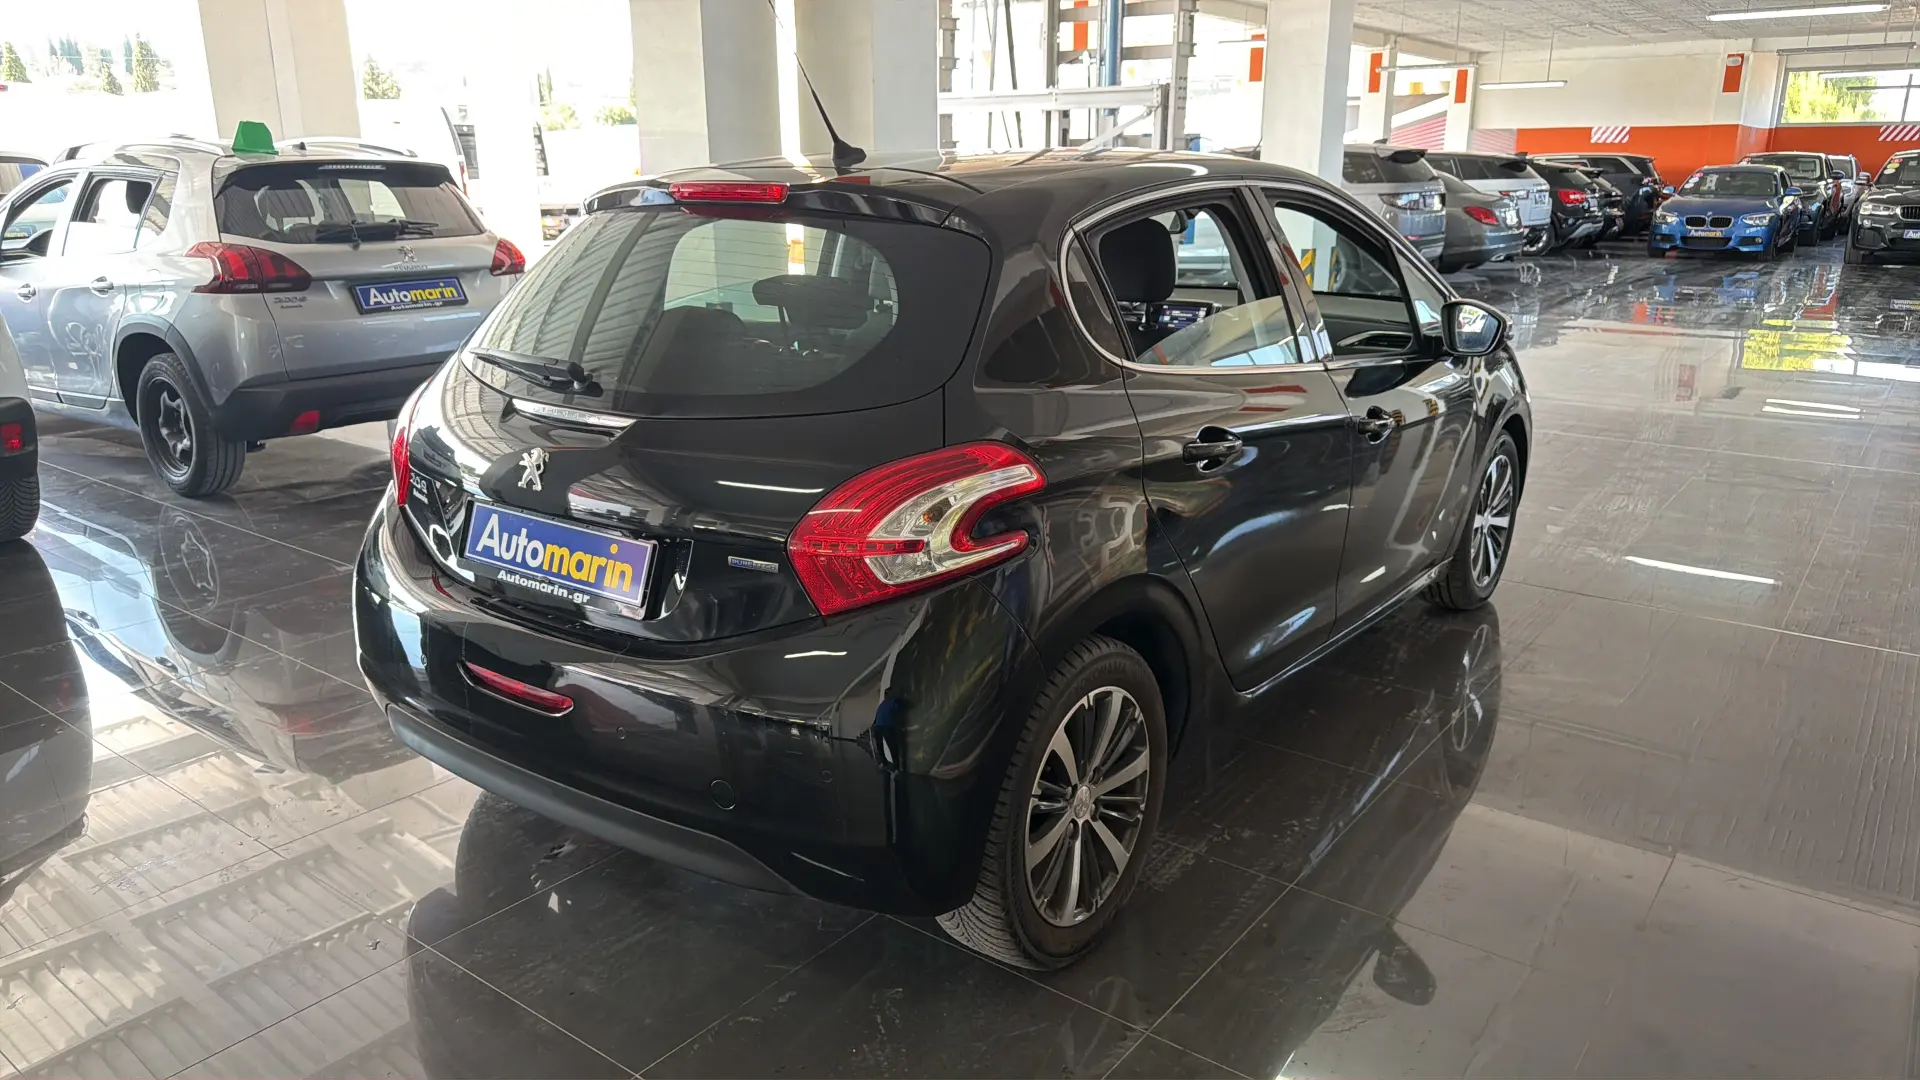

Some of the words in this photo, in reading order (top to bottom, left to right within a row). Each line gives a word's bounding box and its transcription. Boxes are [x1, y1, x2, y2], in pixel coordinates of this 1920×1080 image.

[1690, 229, 1721, 237] Automarin
[369, 282, 458, 306] Automarin
[391, 301, 443, 311] Automarin.gr
[476, 513, 632, 592] Automarin
[497, 570, 590, 604] Automarin.gr
